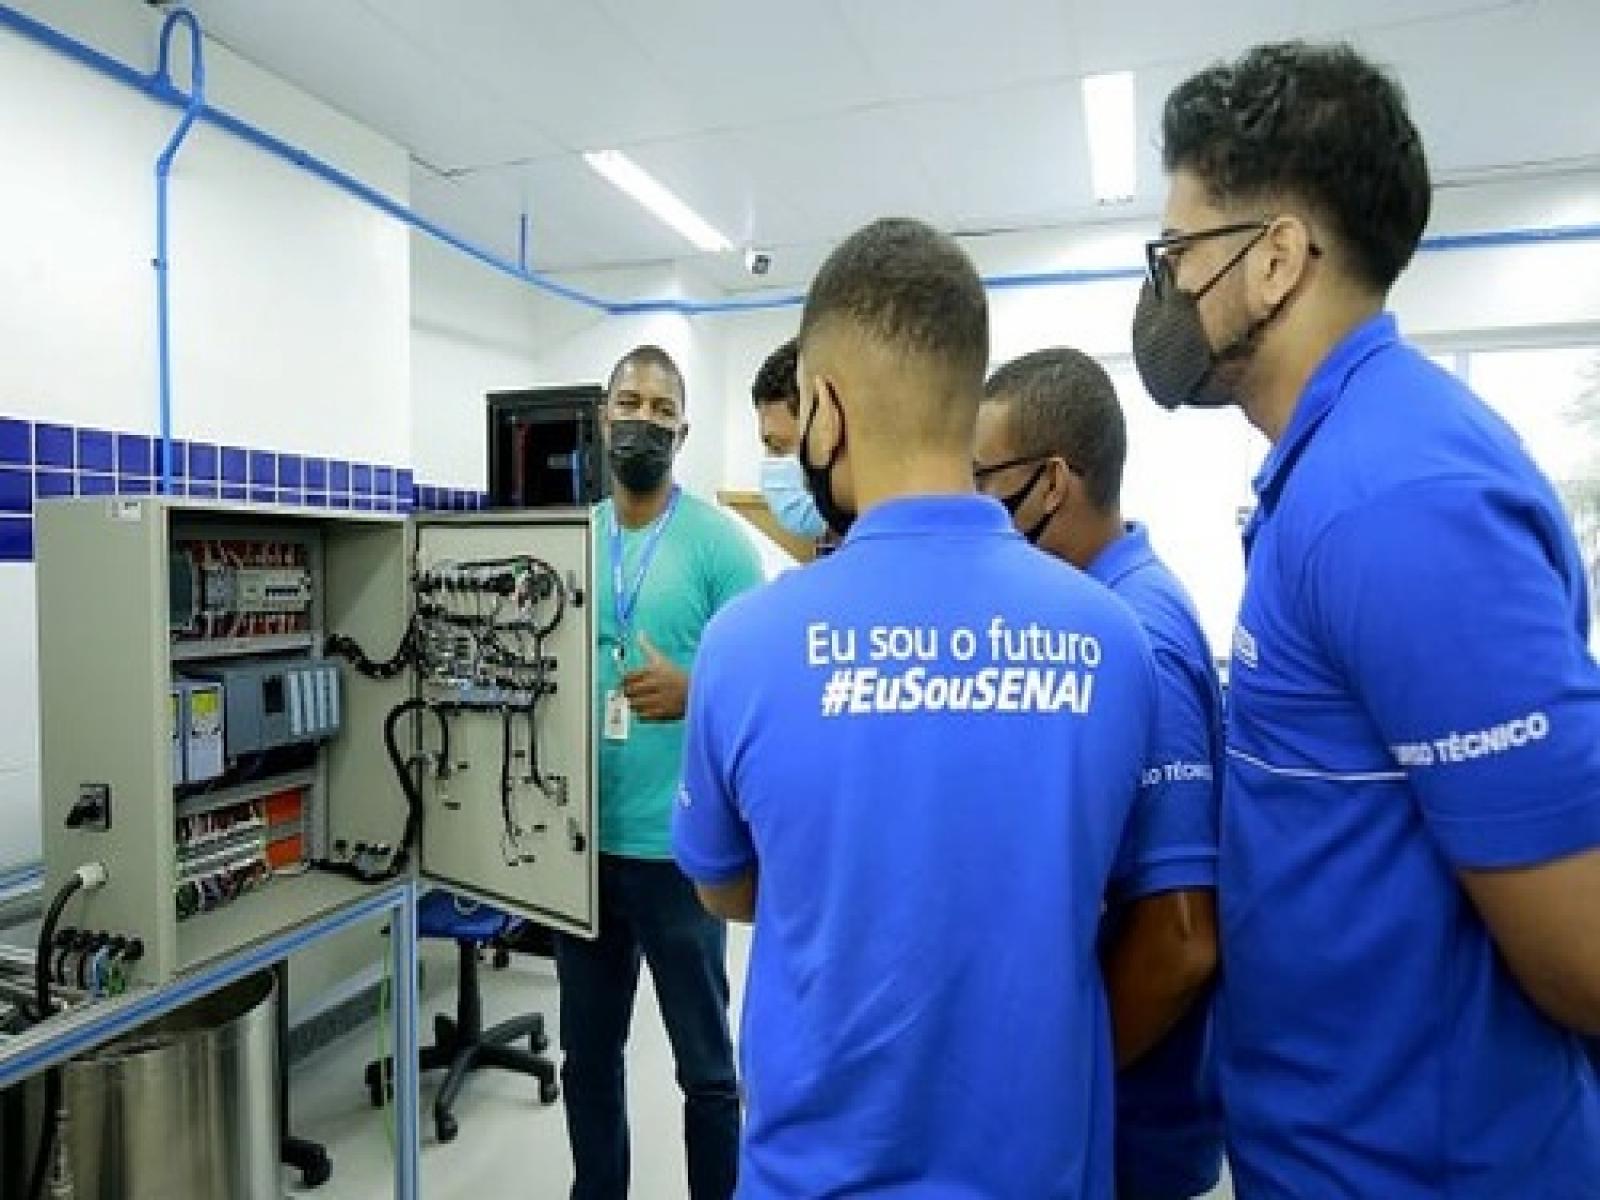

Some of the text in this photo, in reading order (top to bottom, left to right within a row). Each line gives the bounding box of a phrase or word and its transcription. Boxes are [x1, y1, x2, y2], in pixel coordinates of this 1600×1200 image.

[807, 614, 1102, 667] Eu sou o futuro
[821, 666, 1095, 716] #EuSouSENAI
[1434, 712, 1549, 762] TÉCNICO
